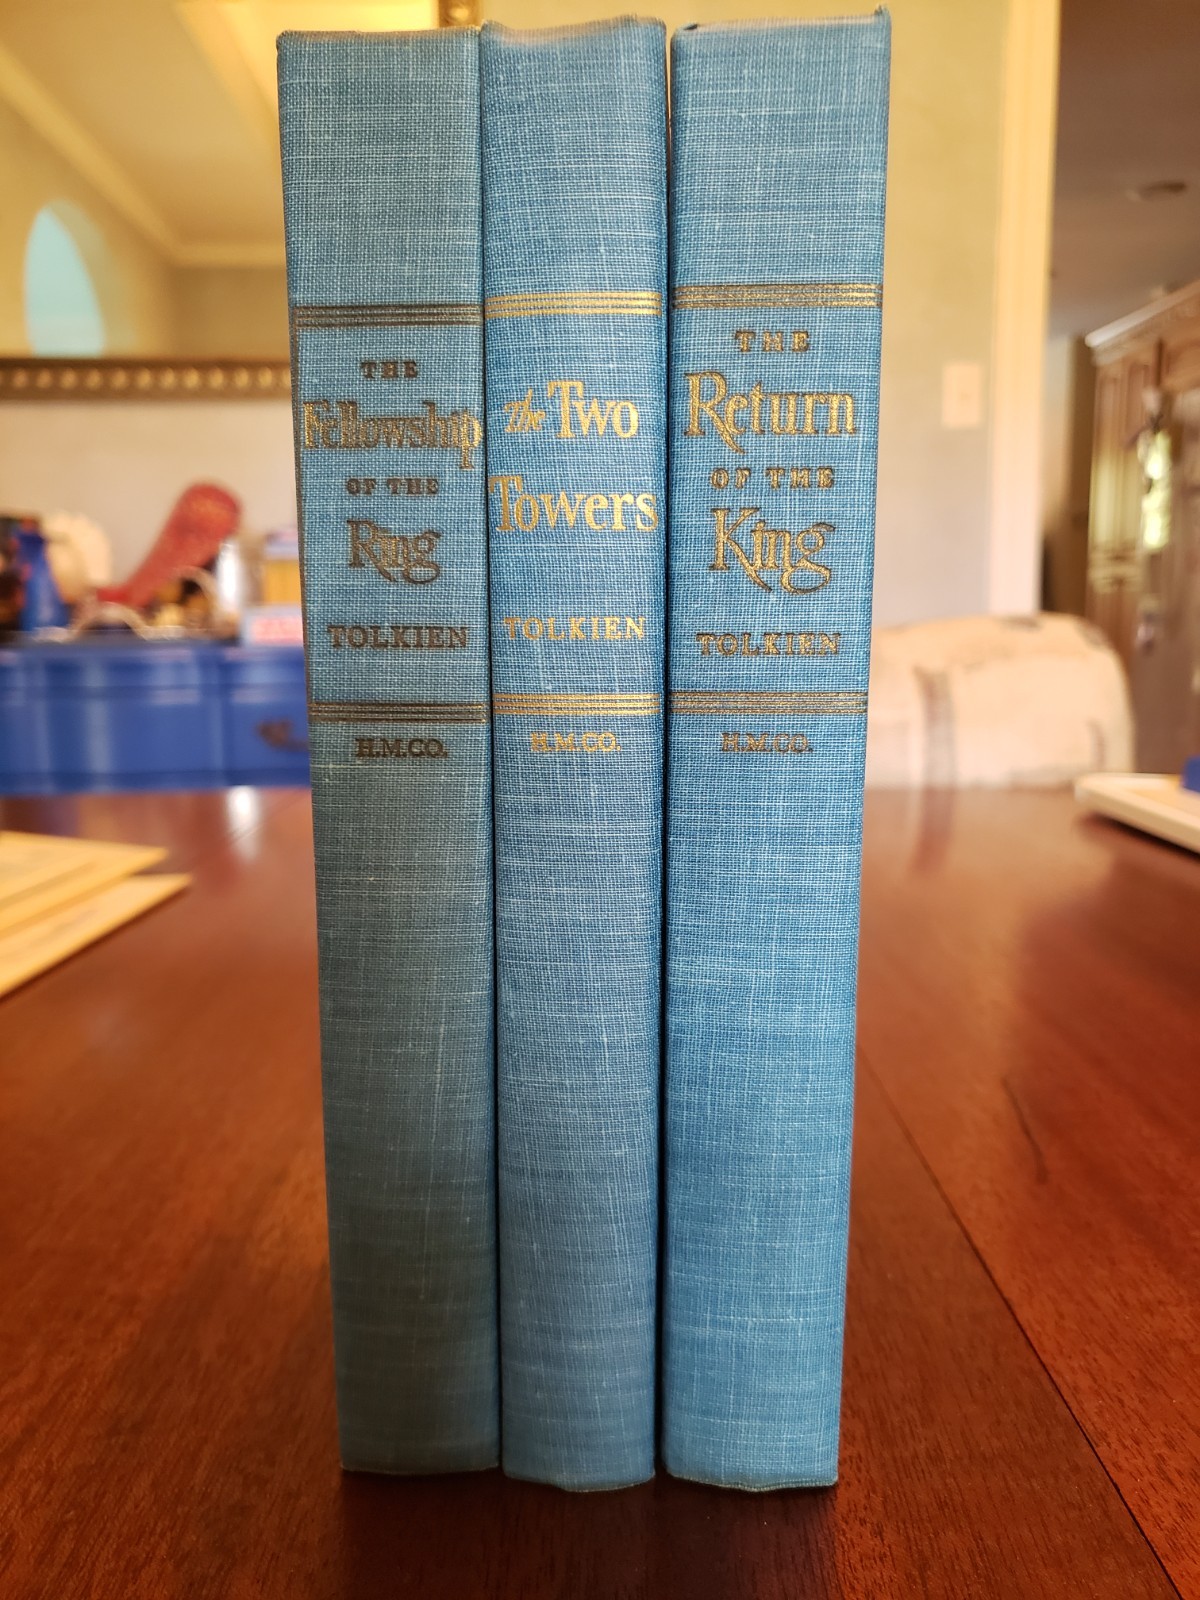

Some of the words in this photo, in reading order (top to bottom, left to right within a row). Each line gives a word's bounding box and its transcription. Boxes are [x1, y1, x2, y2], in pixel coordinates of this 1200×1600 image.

[735, 328, 810, 352] THE
[361, 360, 419, 379] THE
[547, 379, 640, 439] Two
[684, 371, 857, 455] Return
[302, 400, 482, 470] Fellowship
[346, 477, 377, 496] OF
[386, 477, 439, 495] THE
[710, 466, 751, 490] OF
[765, 466, 836, 490] THE
[487, 474, 659, 532] Towers
[347, 518, 442, 585] Ring
[708, 507, 836, 595] King
[327, 624, 468, 649] TOLKIEN
[503, 615, 646, 641] TOLKIEN
[696, 632, 842, 656] TOLKIEN
